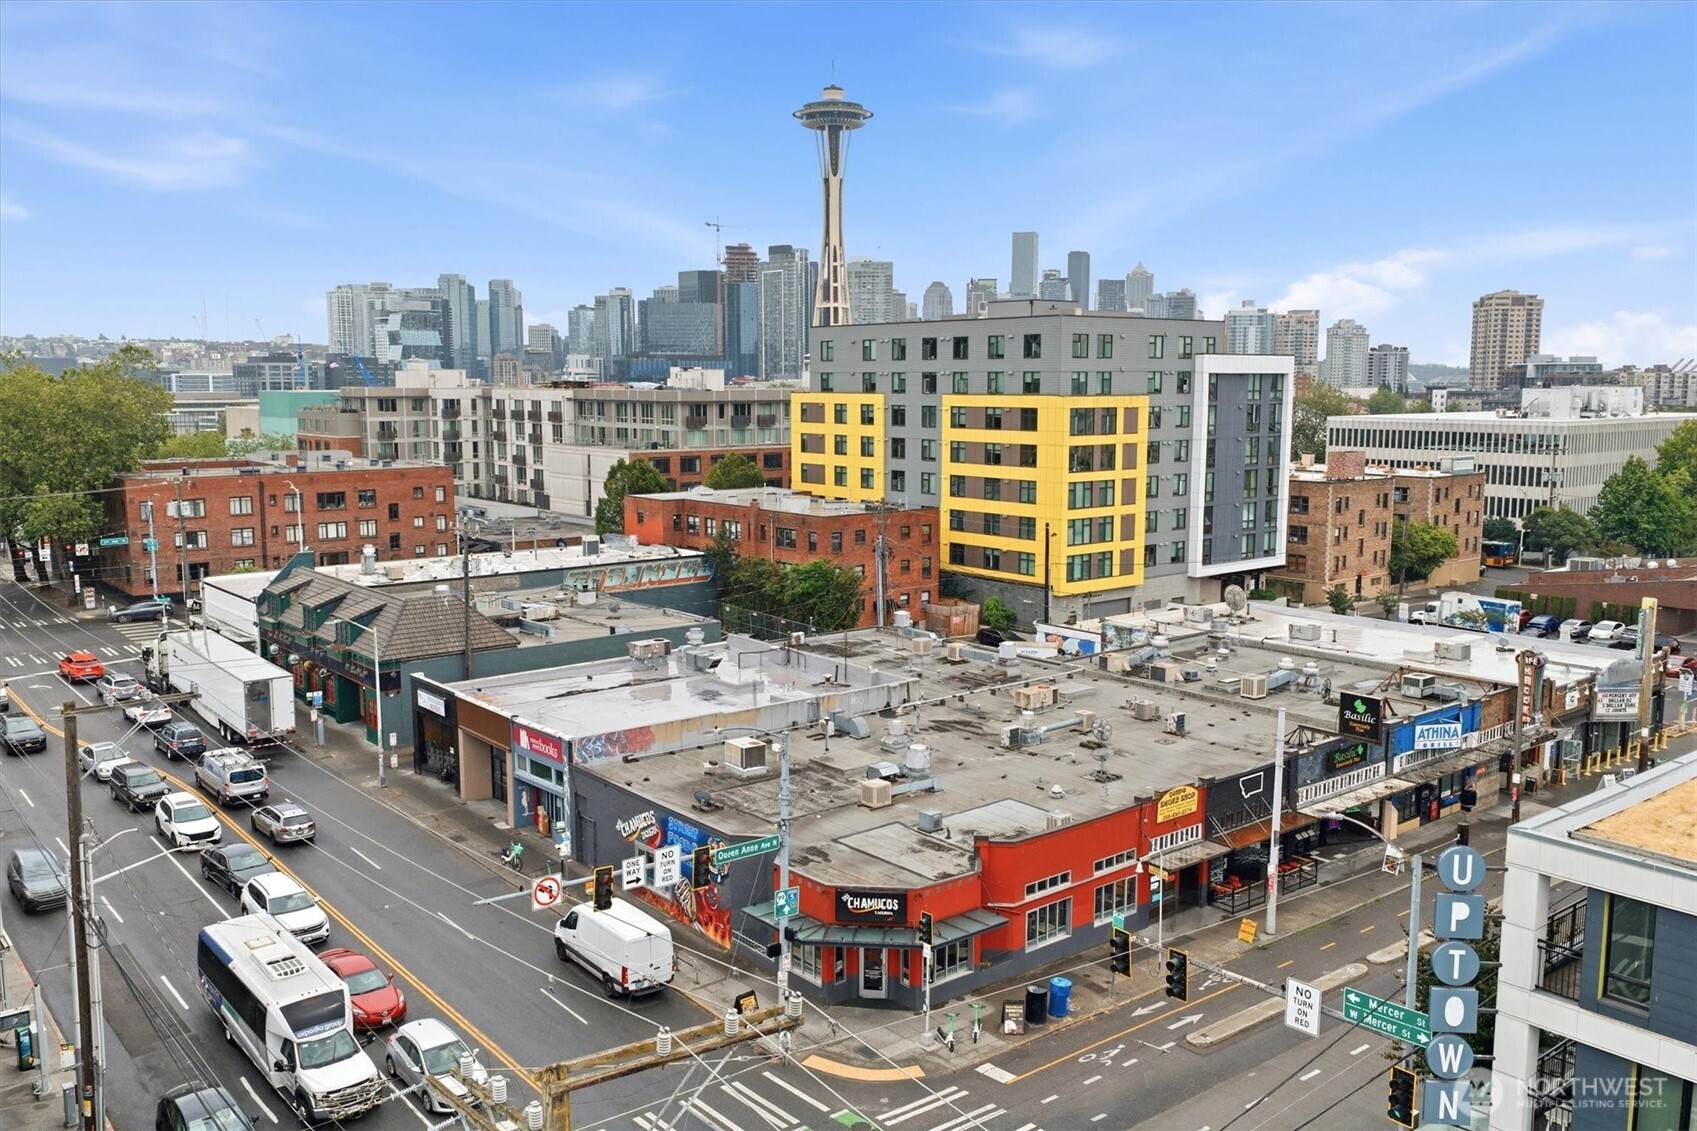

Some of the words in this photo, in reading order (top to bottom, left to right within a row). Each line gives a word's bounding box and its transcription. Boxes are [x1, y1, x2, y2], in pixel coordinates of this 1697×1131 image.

[1343, 710, 1376, 724] Basilic
[1417, 726, 1460, 740] ATHINA
[540, 738, 558, 758] books
[1334, 746, 1357, 763] Basilic
[1160, 796, 1179, 808] SMOKE
[1180, 791, 1196, 802] SHOP
[620, 810, 656, 837] CHAMUCOS
[668, 816, 699, 839] STREET
[661, 850, 675, 860] NO
[718, 849, 739, 860] Queen
[741, 844, 759, 855] Anne
[760, 842, 771, 850] Ave
[772, 839, 778, 847] N
[626, 859, 641, 869] ONE
[660, 859, 676, 868] TURN
[626, 867, 641, 876] WAY
[847, 896, 899, 911] CHAMUCOS
[1295, 985, 1312, 1000] NO
[1439, 854, 1473, 1120] UPTOWN
[1293, 996, 1314, 1010] TURN
[1297, 1008, 1308, 1018] ON
[1368, 998, 1405, 1021] Mercer
[1416, 1018, 1426, 1028] St
[297, 1025, 324, 1038] expedia
[324, 1020, 343, 1030] group
[1294, 1016, 1310, 1029] RED
[1349, 1009, 1358, 1019] W
[1363, 1012, 1398, 1034] Mercer
[1401, 1028, 1411, 1039] St
